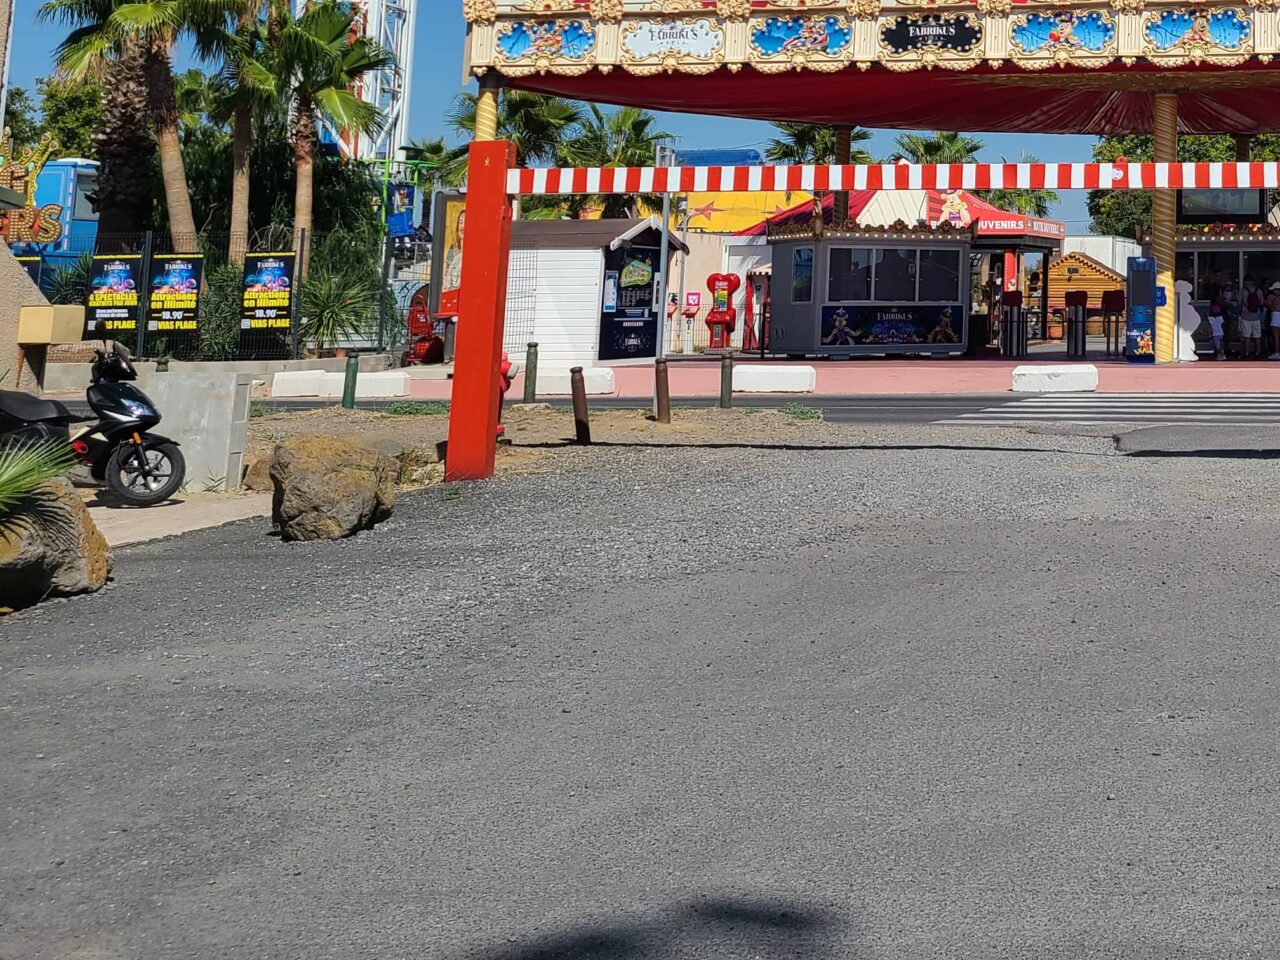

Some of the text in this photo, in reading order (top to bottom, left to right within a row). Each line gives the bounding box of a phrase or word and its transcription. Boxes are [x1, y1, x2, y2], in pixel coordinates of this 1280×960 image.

[649, 29, 698, 41] FABRIKUS
[908, 25, 955, 37] FABRIKUS
[978, 221, 1024, 230] UVENIRS
[95, 292, 138, 301] SPECTACLES
[244, 291, 290, 299] Attractions
[114, 320, 136, 329] PLAGE
[157, 321, 197, 329] VIAS PLAGE
[250, 319, 290, 328] VIAS PLAGE
